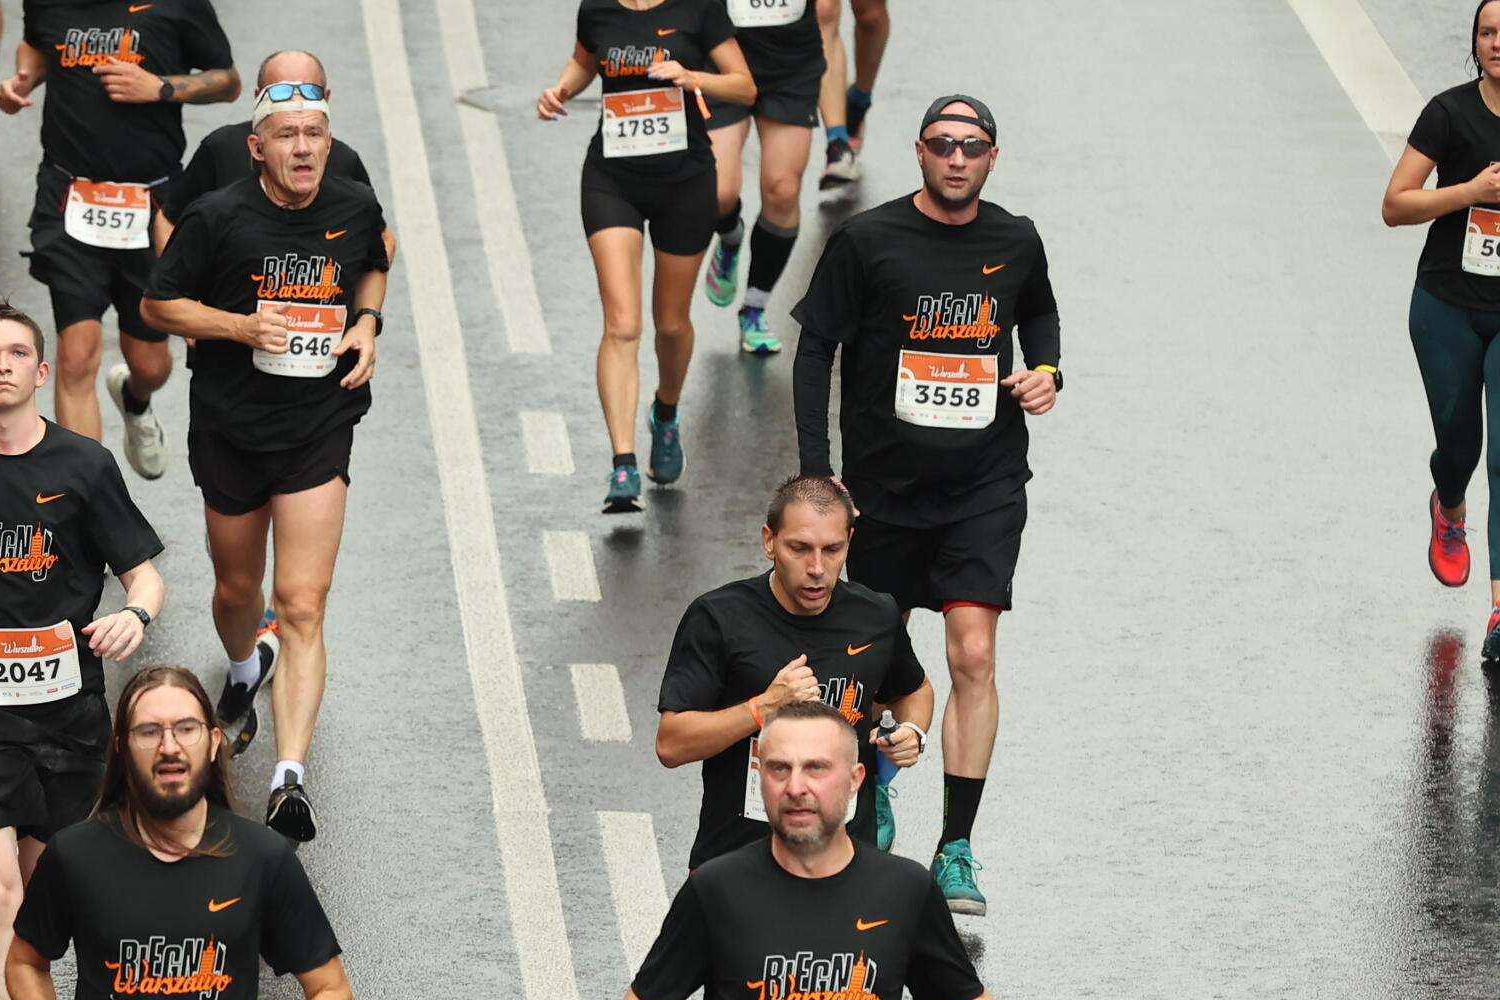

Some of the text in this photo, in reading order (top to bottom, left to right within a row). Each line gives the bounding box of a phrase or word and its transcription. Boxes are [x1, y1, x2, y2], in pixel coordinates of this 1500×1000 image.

[617, 117, 670, 138] 1783
[82, 208, 135, 229] 4557
[1481, 239, 1500, 257] 5
[289, 336, 332, 356] 646
[914, 384, 980, 407] 3558
[105, 958, 233, 995] Warszawo
